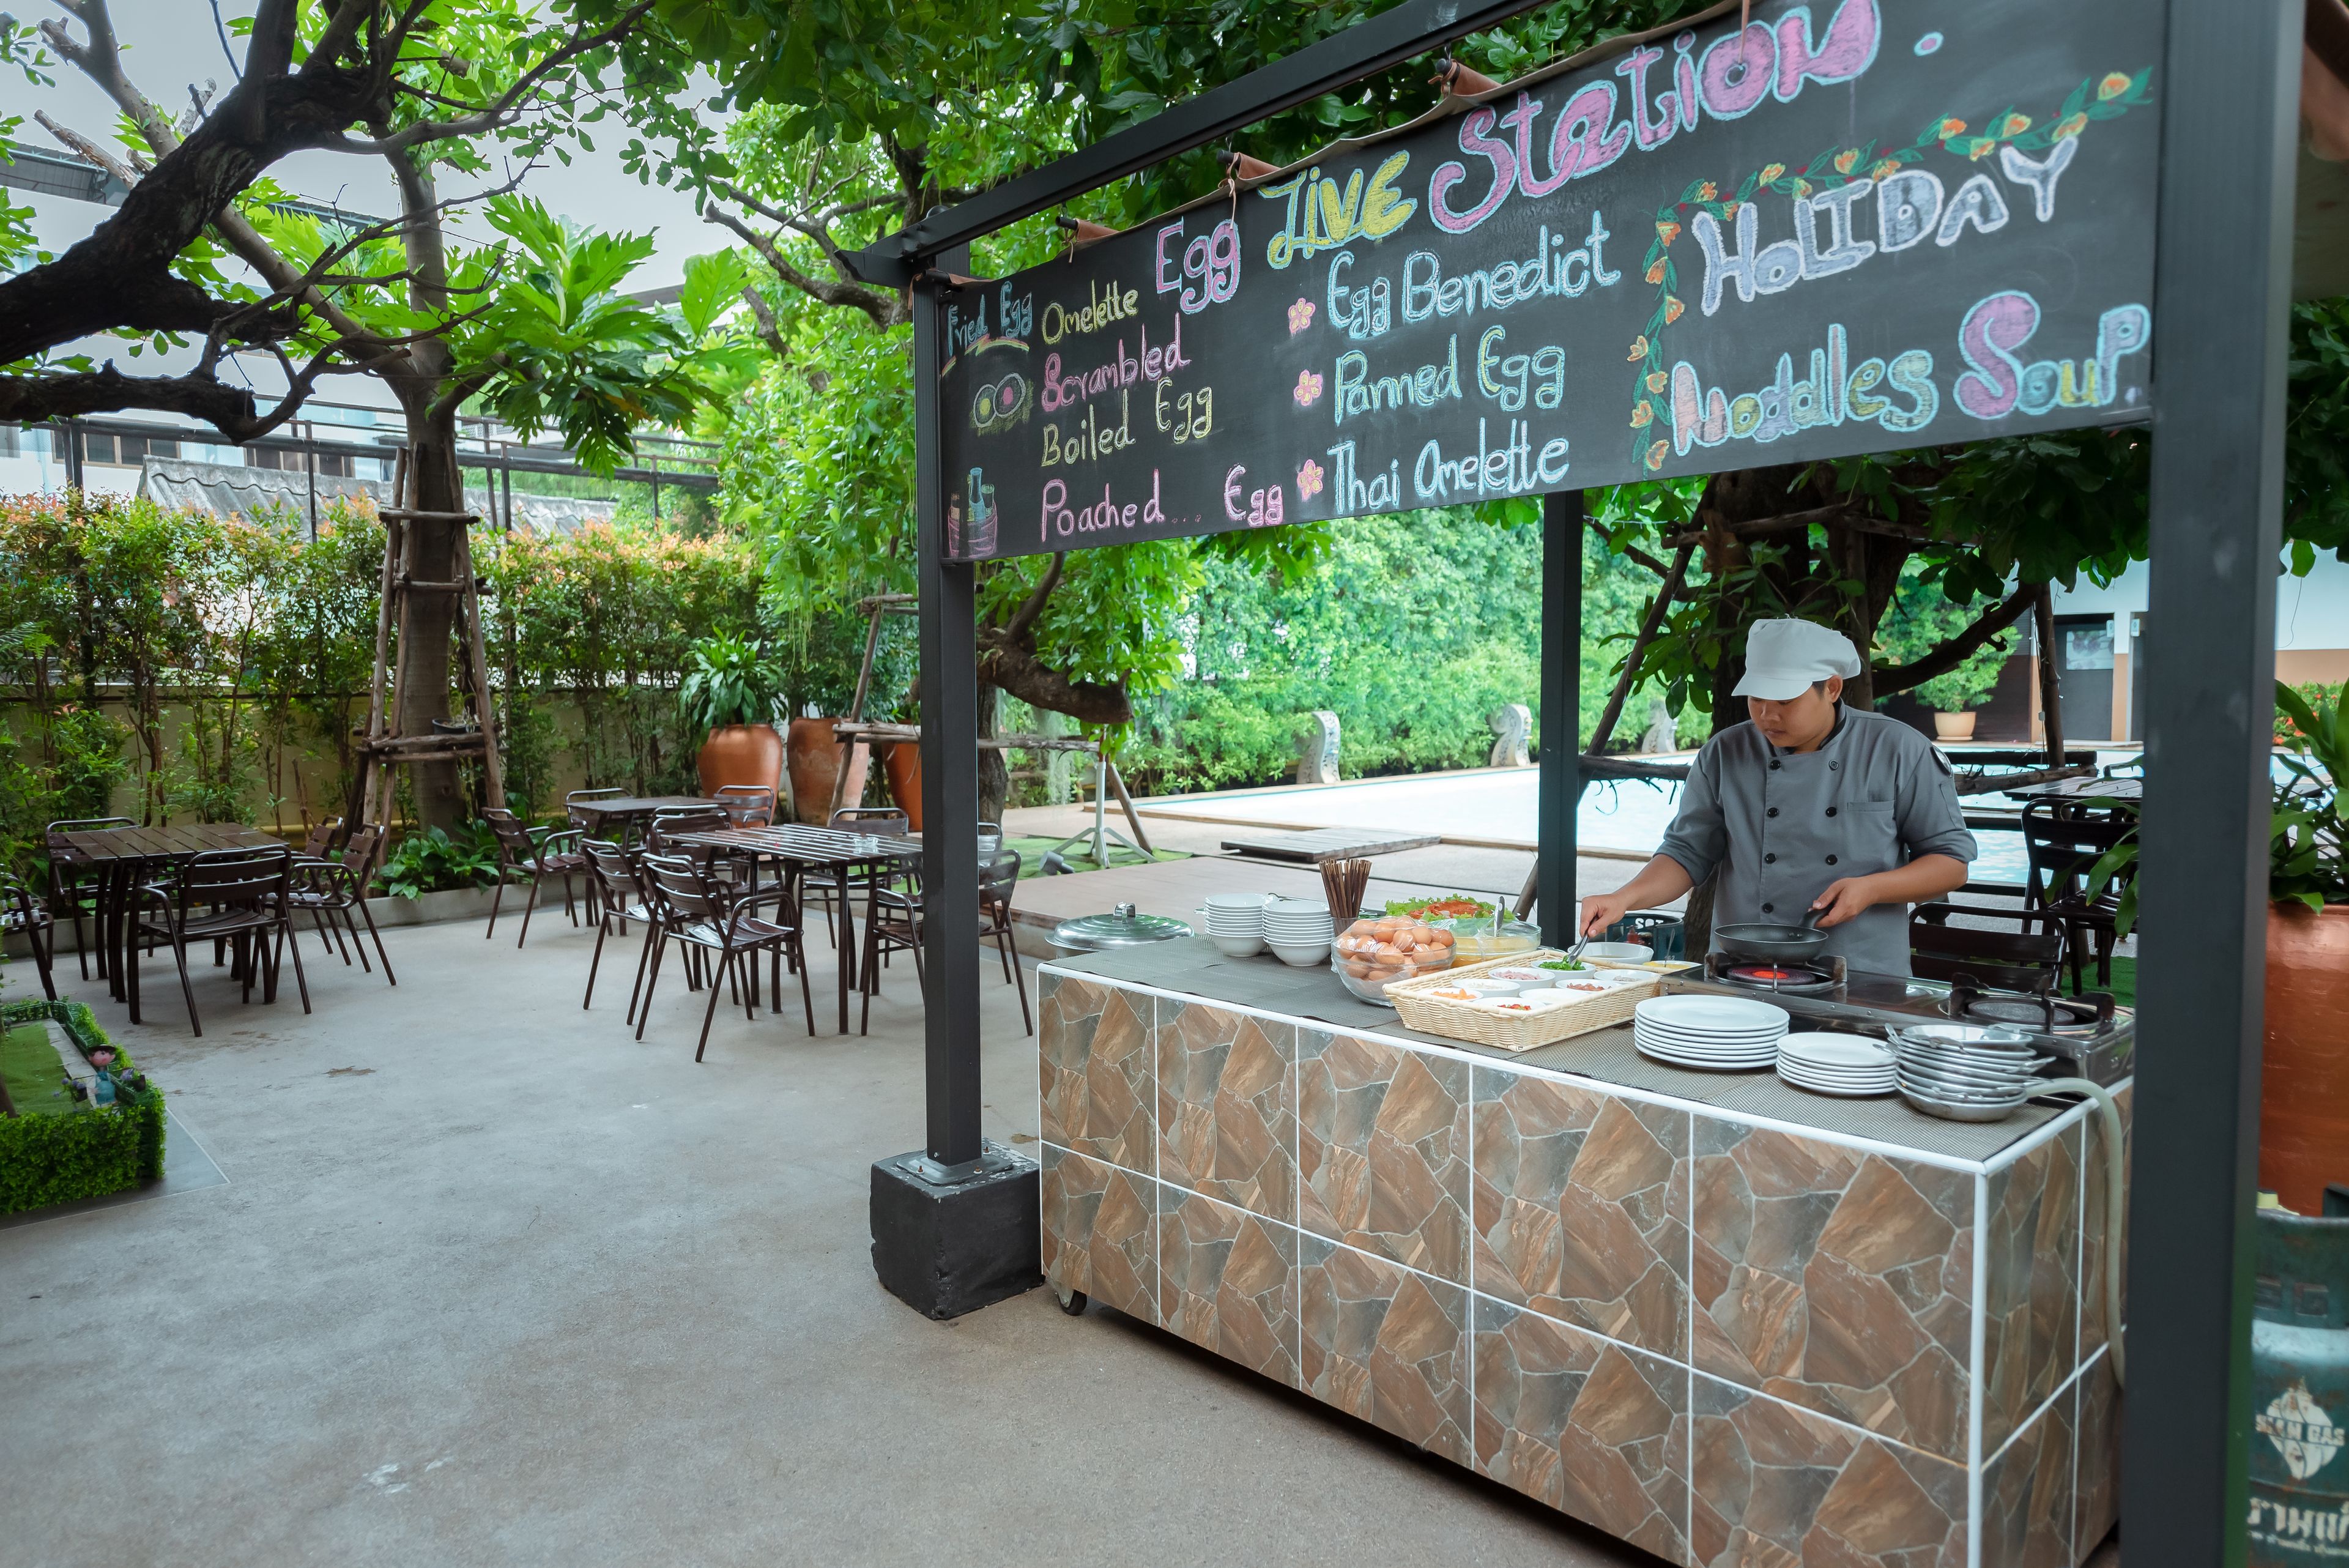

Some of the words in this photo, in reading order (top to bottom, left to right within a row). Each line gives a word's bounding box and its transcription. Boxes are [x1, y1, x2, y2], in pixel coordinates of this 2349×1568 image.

[1156, 216, 1241, 314] Egg
[1327, 251, 1391, 340] Egg
[1401, 210, 1622, 321] Benedict
[948, 294, 988, 357] Fried
[1000, 280, 1032, 339] Egg
[1042, 278, 1139, 345] Omelette
[1041, 311, 1192, 412] Scrambled
[1477, 324, 1566, 412] Egg
[1041, 388, 1136, 467] Boiled
[1155, 376, 1213, 445] Egg
[1224, 464, 1283, 527] Egg
[1326, 439, 1401, 515] Thai
[2307, 1424, 2345, 1447] GAS
